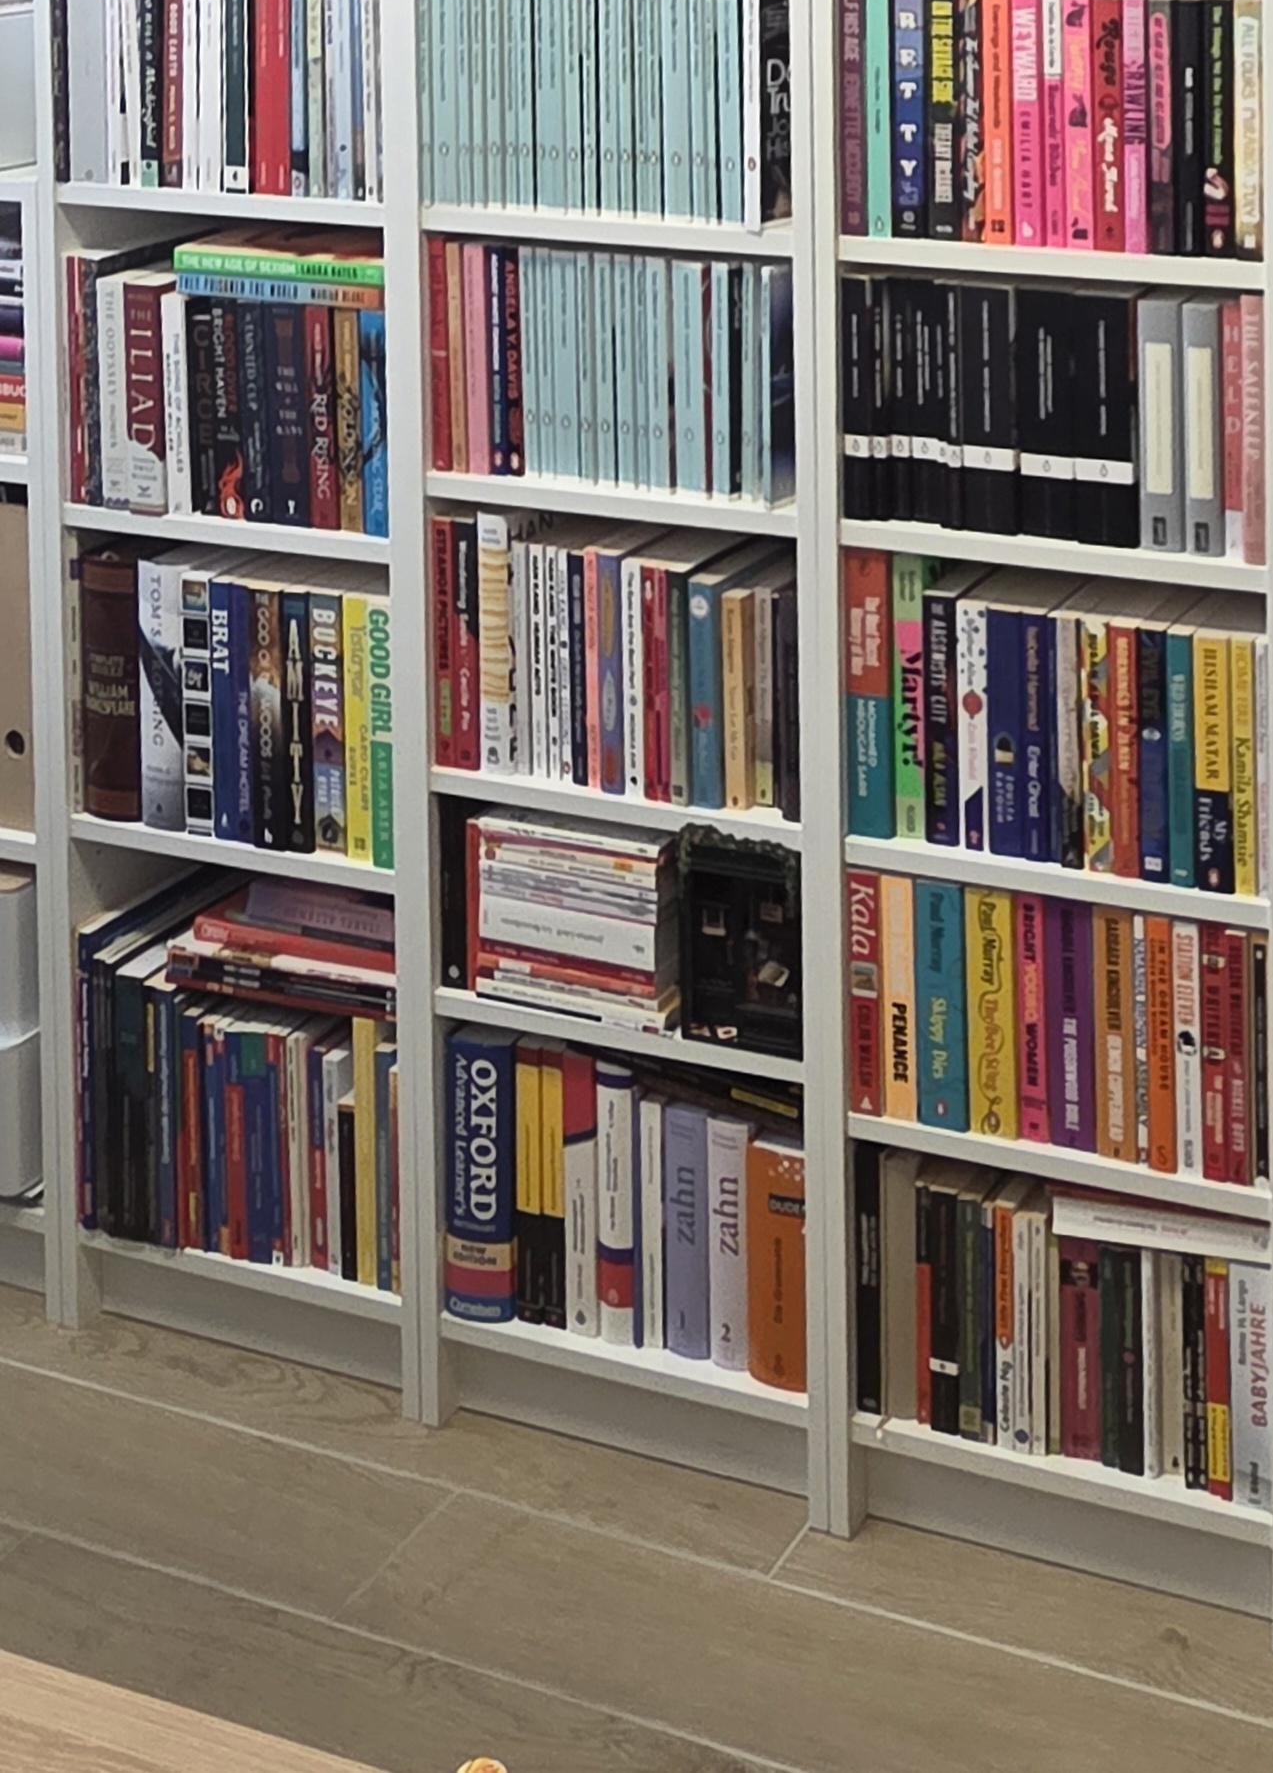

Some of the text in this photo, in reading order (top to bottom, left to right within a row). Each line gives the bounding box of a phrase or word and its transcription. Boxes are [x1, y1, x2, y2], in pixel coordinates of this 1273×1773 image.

[843, 12, 858, 32] HIS
[843, 34, 859, 61] AGE
[1012, 6, 1037, 101] WEYWARD
[503, 260, 517, 330] ANGELA
[129, 328, 154, 455] ILIAD
[506, 349, 518, 399] DAVIS
[312, 393, 330, 499] RED RISING
[435, 528, 448, 596] STRANGE
[212, 609, 229, 674] BRAT
[311, 607, 338, 736] BUCKEYE
[368, 609, 392, 737] GOOD GIRL
[898, 650, 923, 768] Martyr!
[1202, 648, 1220, 780] HISHAM MATAR
[850, 882, 876, 955] Kala
[1022, 902, 1039, 1087] BRIGHT YOUNG WOMEN
[892, 1002, 909, 1083] PENANCE
[452, 1053, 468, 1132] Advanced
[470, 1058, 498, 1220] OXFORD
[669, 1166, 696, 1245] zahn
[717, 1175, 739, 1257] zahn
[720, 1323, 732, 1343] 2
[1249, 1303, 1269, 1428] BABYJAHRE
